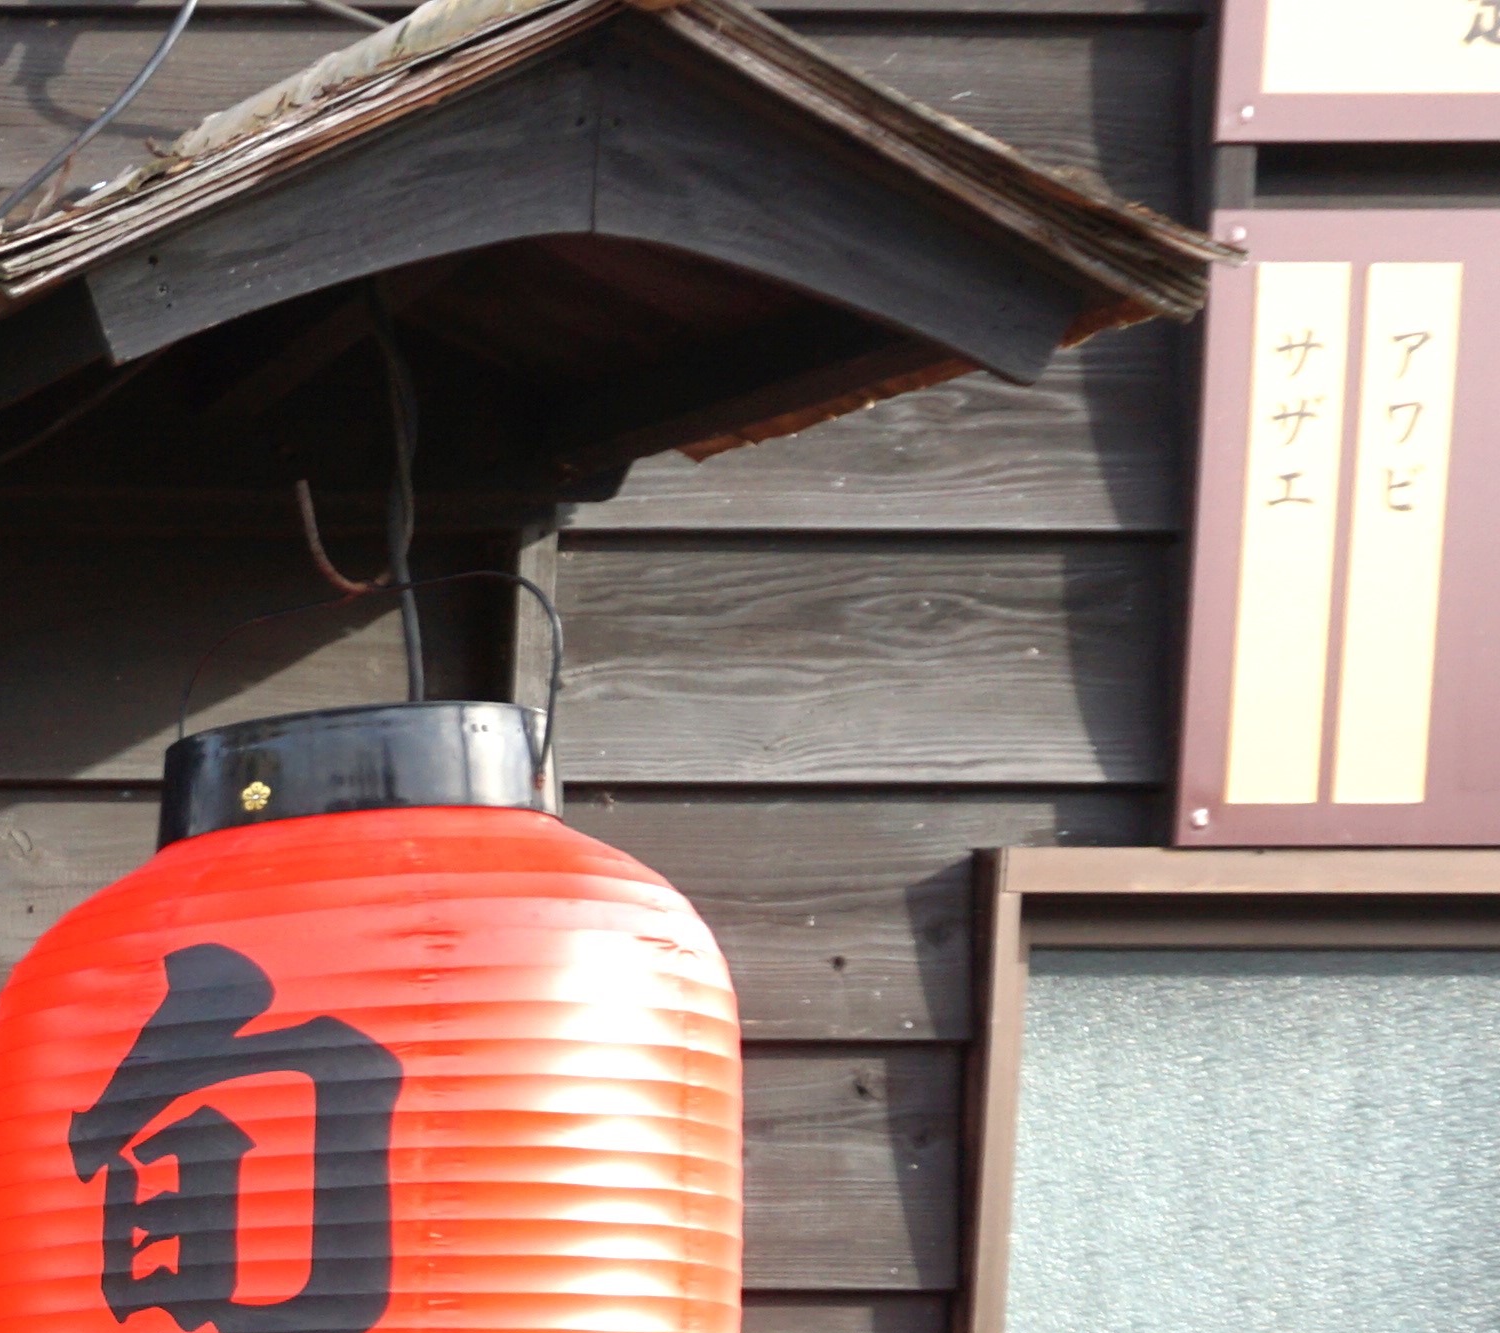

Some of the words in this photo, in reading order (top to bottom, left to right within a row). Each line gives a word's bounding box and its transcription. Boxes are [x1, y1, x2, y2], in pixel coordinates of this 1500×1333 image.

[1266, 328, 1325, 506] サザエ
[1385, 330, 1432, 512] アワビ
